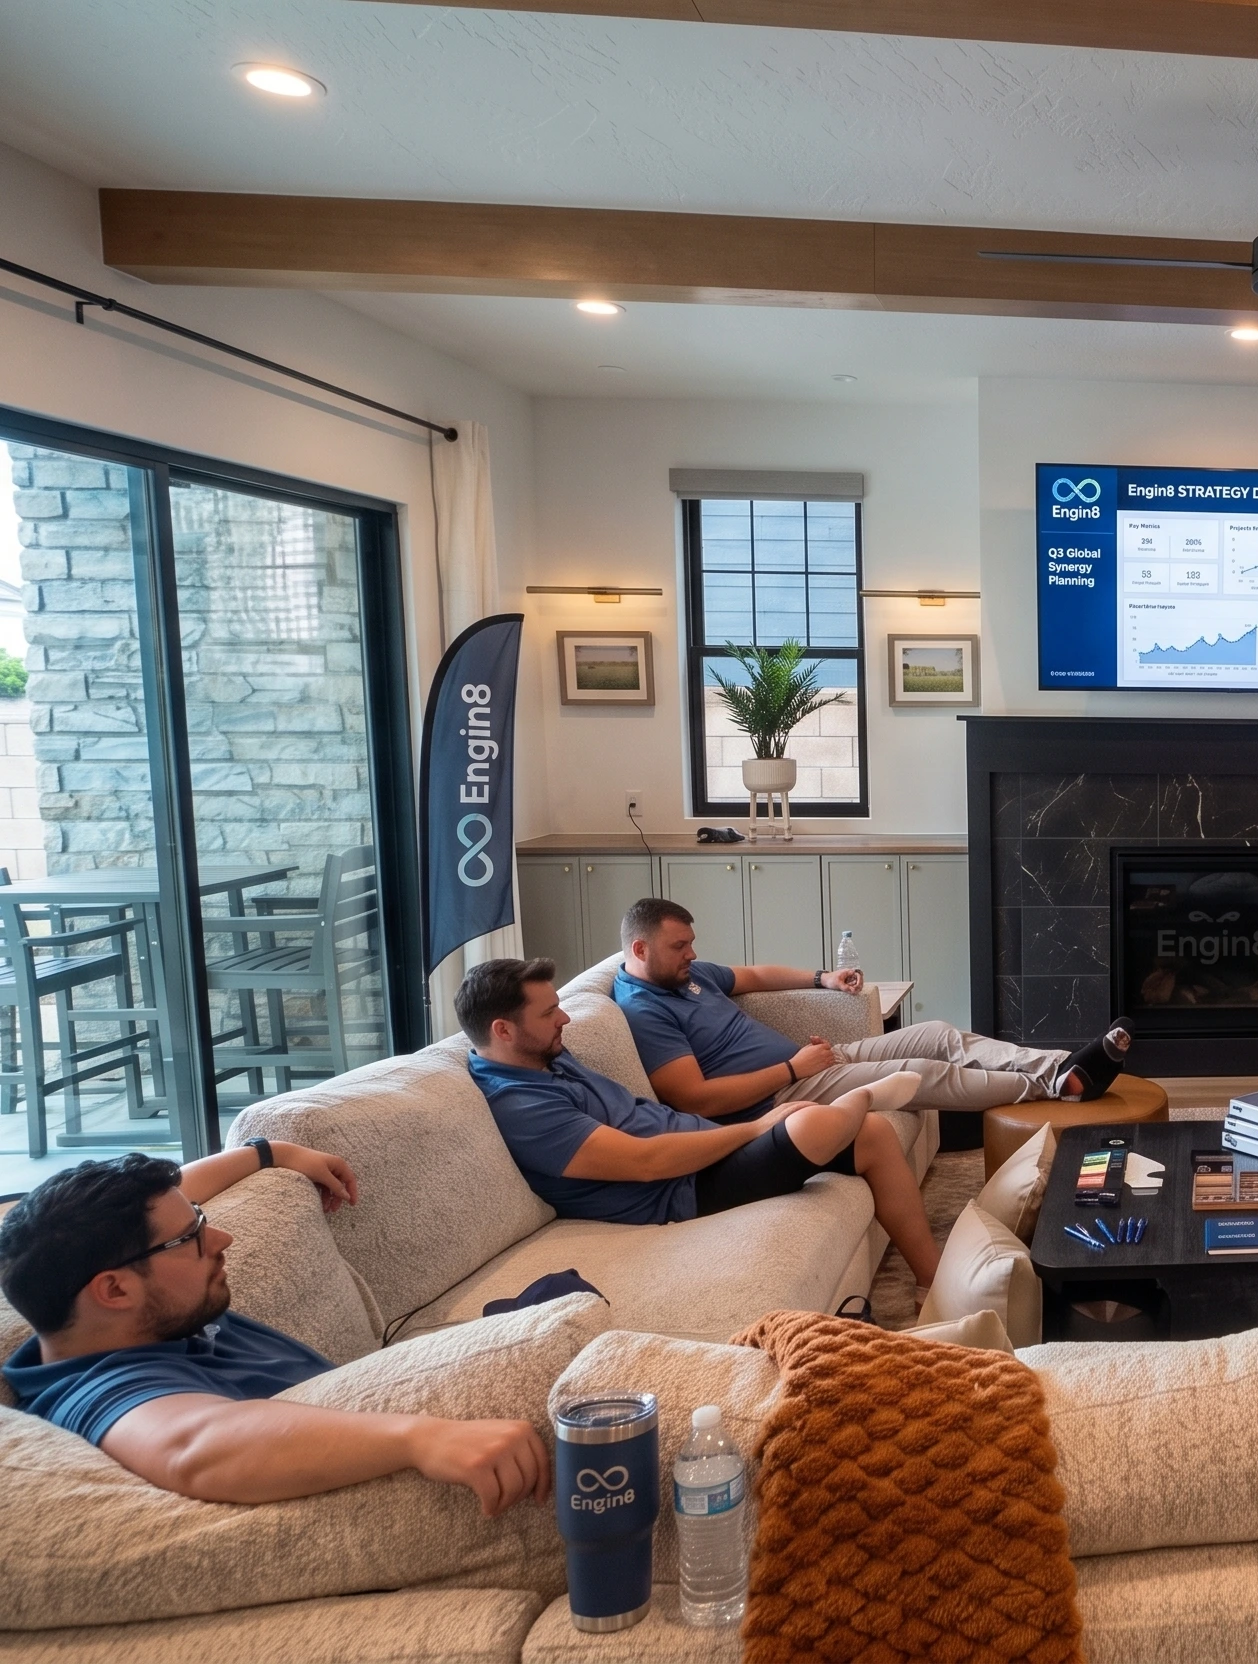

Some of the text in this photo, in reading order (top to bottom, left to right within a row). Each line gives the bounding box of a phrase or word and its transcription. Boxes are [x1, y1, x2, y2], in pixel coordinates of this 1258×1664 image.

[1128, 483, 1175, 499] Engin8
[1178, 485, 1250, 499] STRATEGY
[1052, 505, 1100, 521] Engin8
[1048, 548, 1101, 559] Q3 Global
[1048, 562, 1093, 574] Synergy
[1048, 575, 1095, 588] Planning
[459, 683, 499, 804] Engin8
[570, 1488, 636, 1515] Engin8
